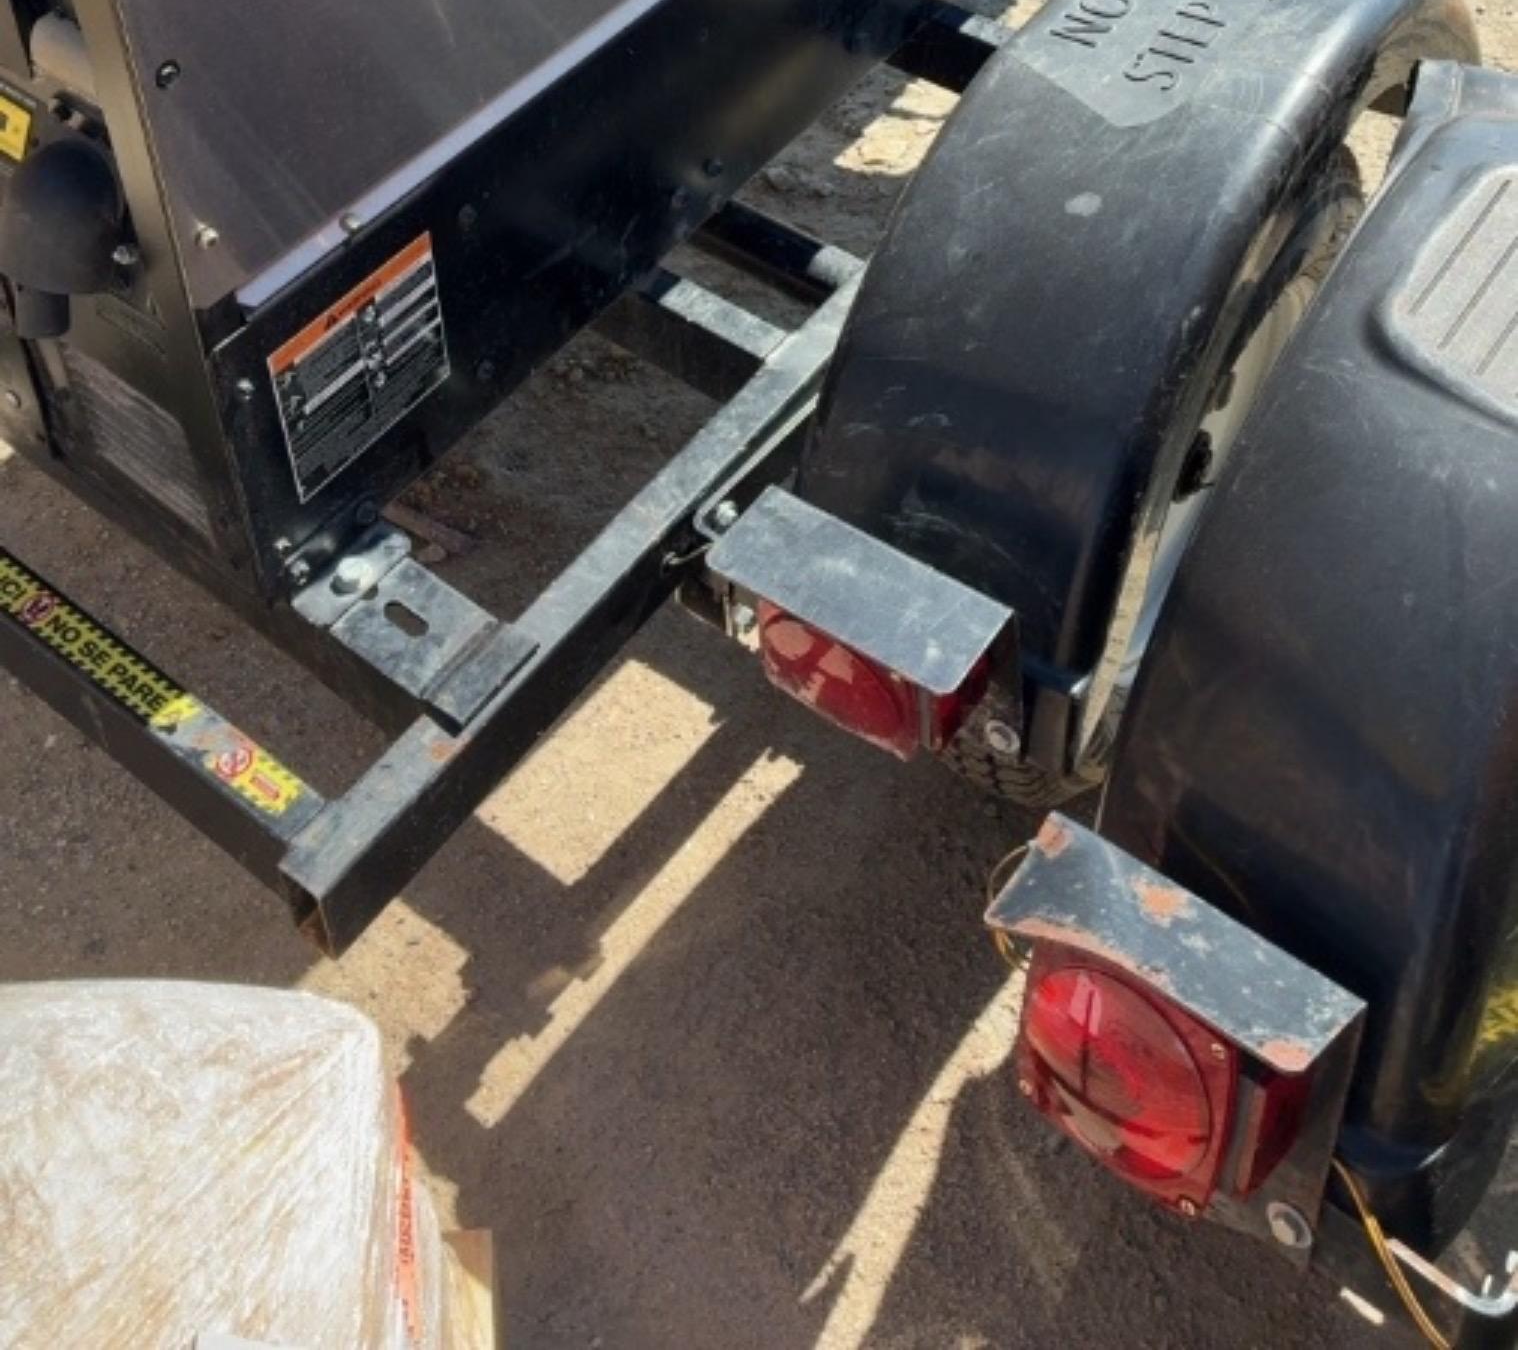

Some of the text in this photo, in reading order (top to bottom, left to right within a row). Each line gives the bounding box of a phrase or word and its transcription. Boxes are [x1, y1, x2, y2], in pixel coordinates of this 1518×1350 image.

[1122, 2, 1227, 91] STEP
[45, 614, 81, 644] NO
[79, 640, 110, 668] SE
[108, 662, 168, 712] PARE
